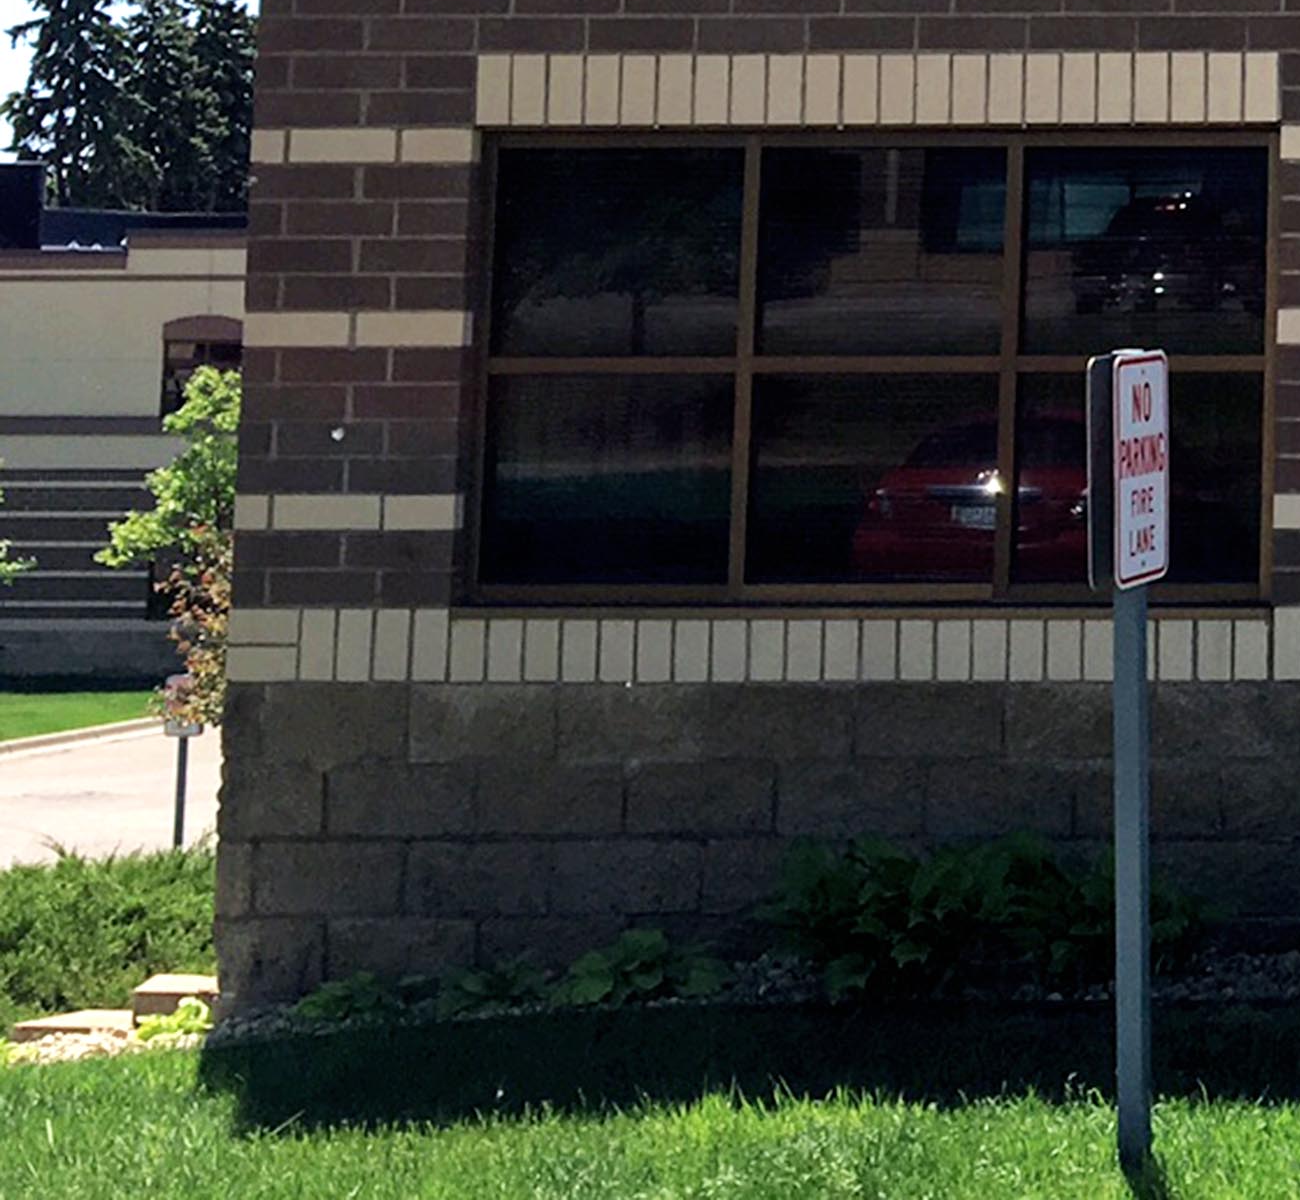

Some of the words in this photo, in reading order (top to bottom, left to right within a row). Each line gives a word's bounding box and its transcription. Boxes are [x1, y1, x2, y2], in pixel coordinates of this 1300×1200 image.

[1131, 381, 1152, 424] NO
[1120, 432, 1165, 478] PARKING
[1131, 486, 1154, 517] FIRE
[1130, 524, 1156, 557] LANE
